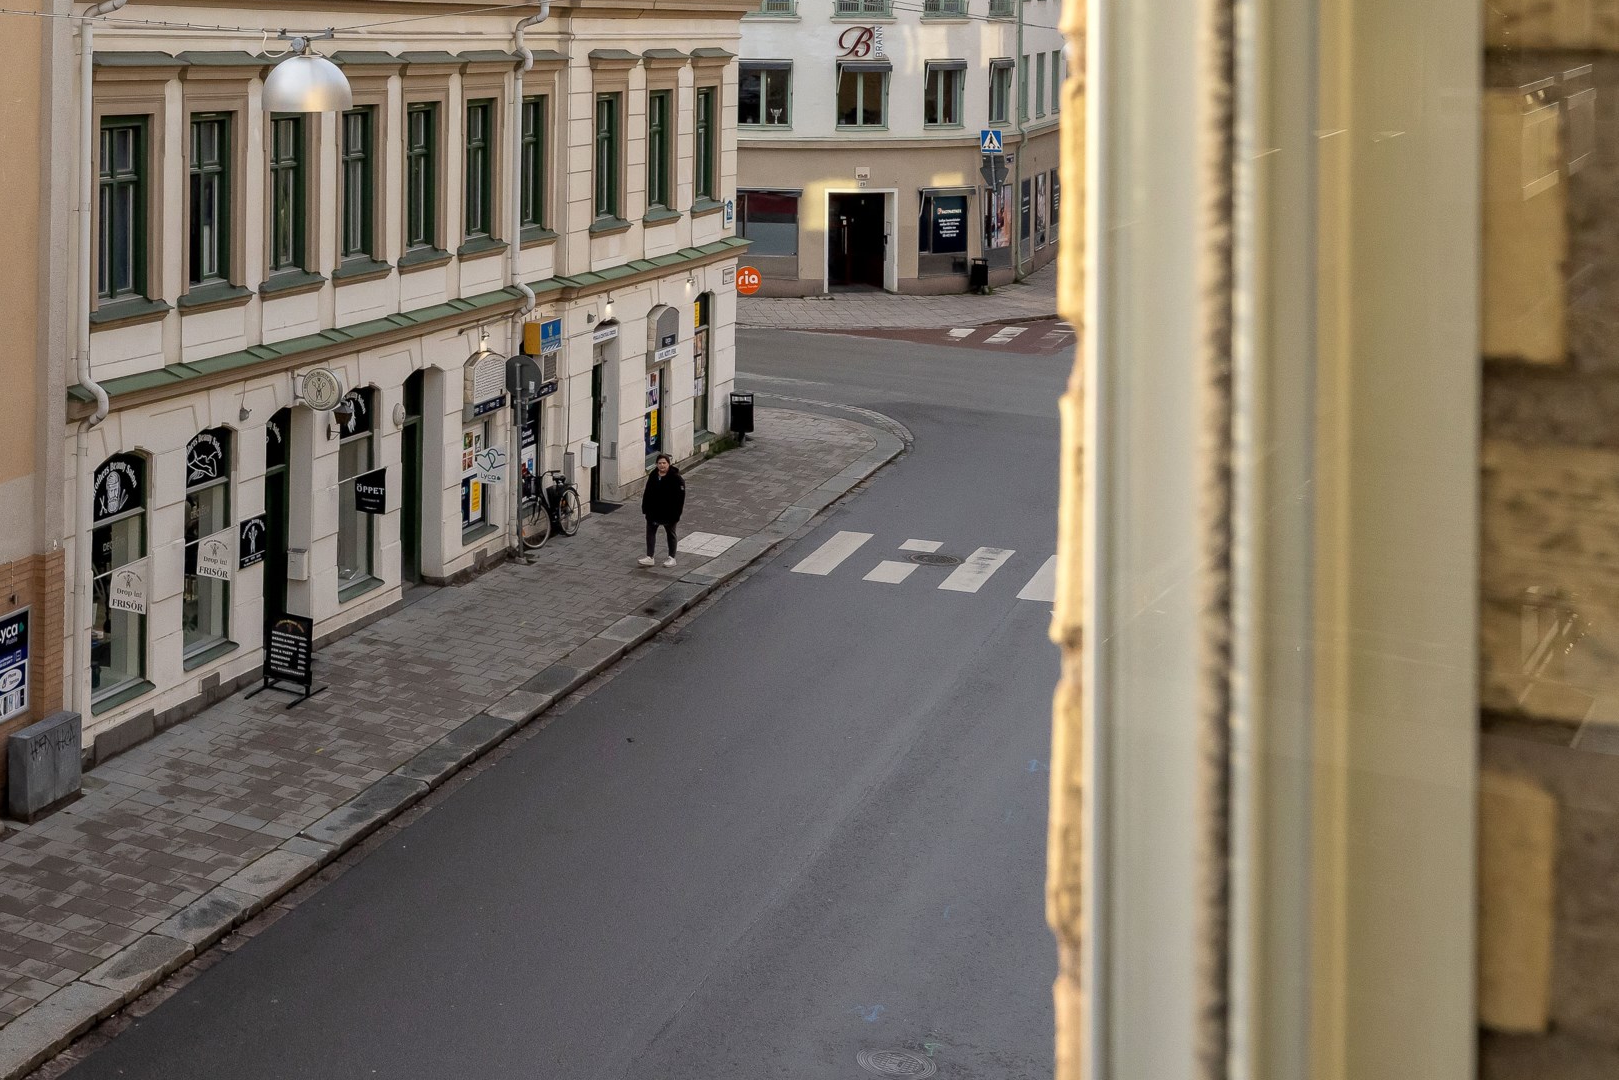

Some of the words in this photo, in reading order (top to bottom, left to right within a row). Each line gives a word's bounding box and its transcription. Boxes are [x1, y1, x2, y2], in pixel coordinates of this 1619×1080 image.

[875, 26, 883, 58] BRANN
[738, 270, 759, 285] ria
[480, 471, 497, 481] Lyca
[356, 483, 385, 496] ÖPPET
[203, 555, 219, 565] Drop
[198, 566, 229, 579] FRISÖR
[116, 587, 133, 597] Drop
[112, 599, 143, 612] FRISÖR
